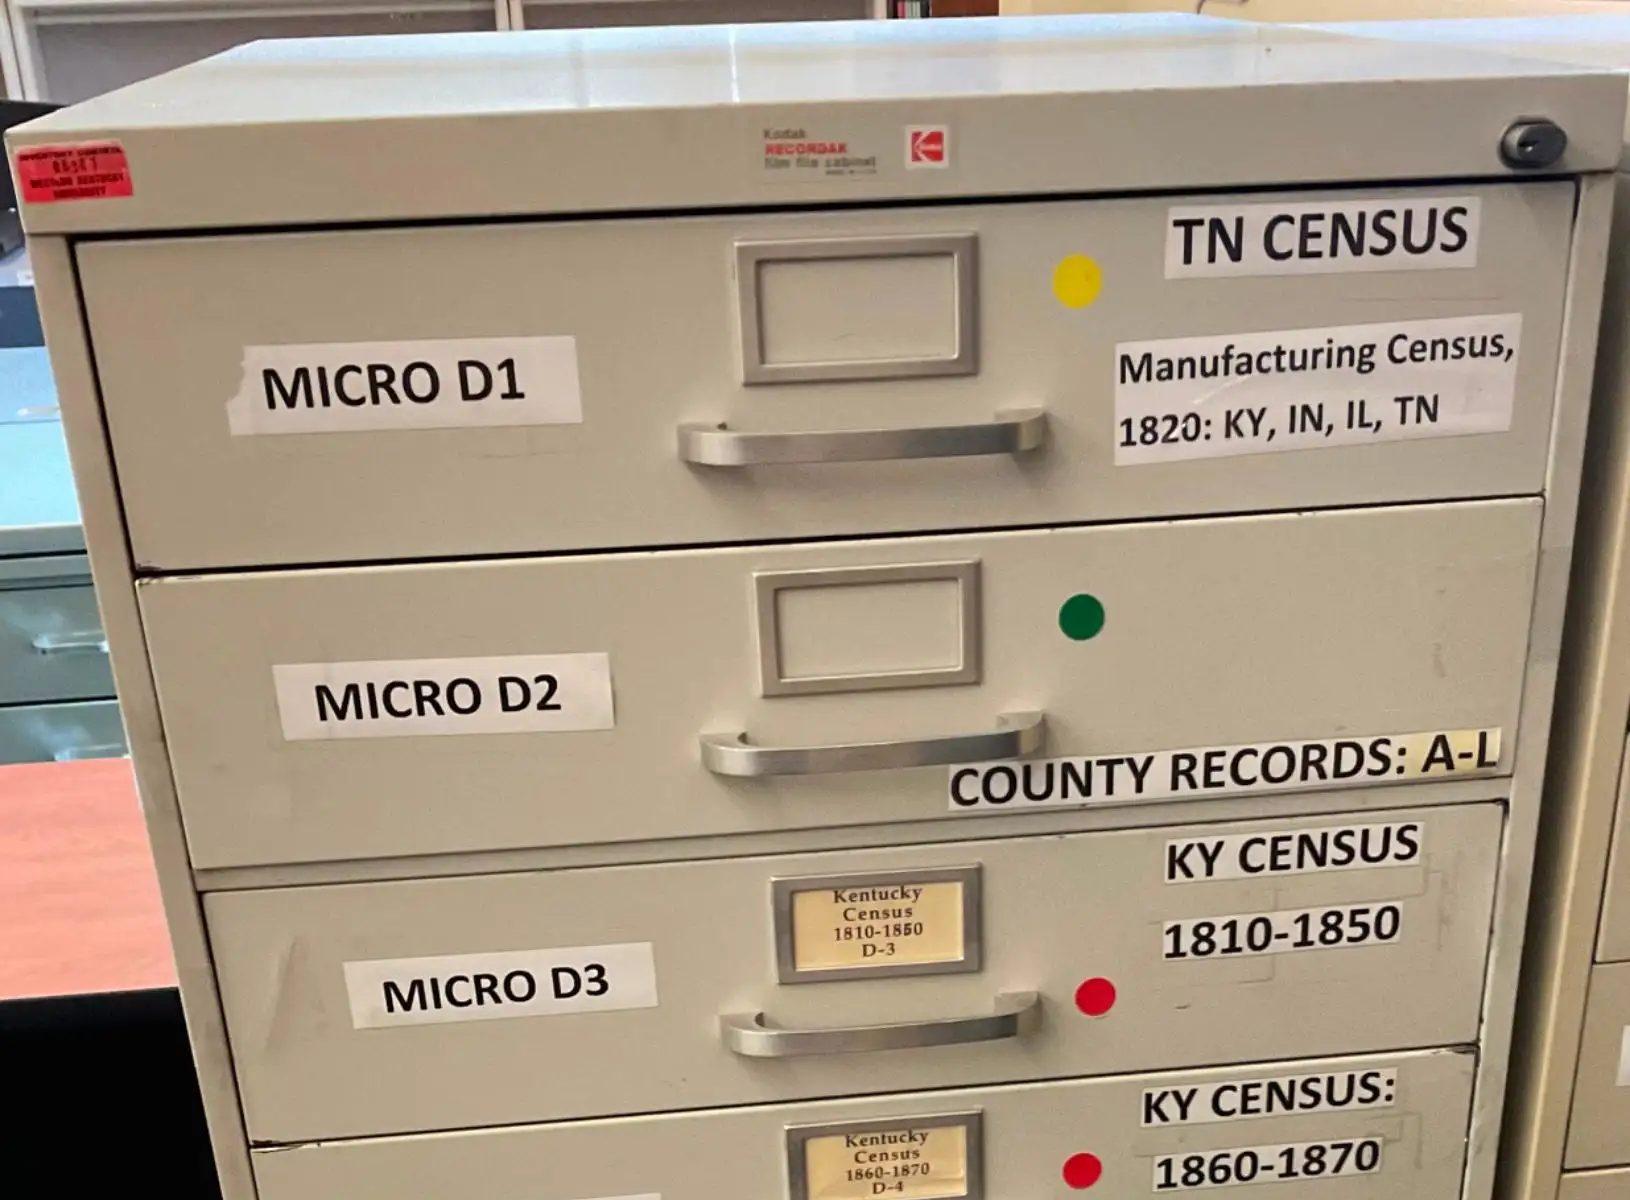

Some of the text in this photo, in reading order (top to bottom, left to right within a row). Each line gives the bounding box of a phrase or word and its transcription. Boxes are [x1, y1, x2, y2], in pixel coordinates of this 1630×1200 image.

[1173, 205, 1469, 265] TN CENSUS
[263, 357, 526, 409] MICRO D1
[1120, 334, 1513, 384] Manufacturing Census,
[1121, 394, 1438, 447] 1820: KY, IN, IL, TN
[315, 675, 561, 721] MICRO D2
[951, 732, 1498, 807] COUNTY RECORDS: A-L
[1168, 825, 1417, 879] KY CENSUS
[834, 885, 923, 903] Kentucky
[843, 906, 914, 922] Census
[834, 922, 924, 941] 1810-1850
[862, 942, 896, 957] D-3
[1165, 906, 1399, 958] 1810-1850
[384, 964, 608, 1013] MICRO D3
[1145, 1072, 1394, 1123] KY CENSUS:
[846, 1129, 929, 1148] Kentucky
[854, 1149, 921, 1164] Census
[846, 1162, 930, 1181] 1860-1870
[872, 1181, 904, 1195] D-4
[1157, 1141, 1379, 1189] 1860-1870
